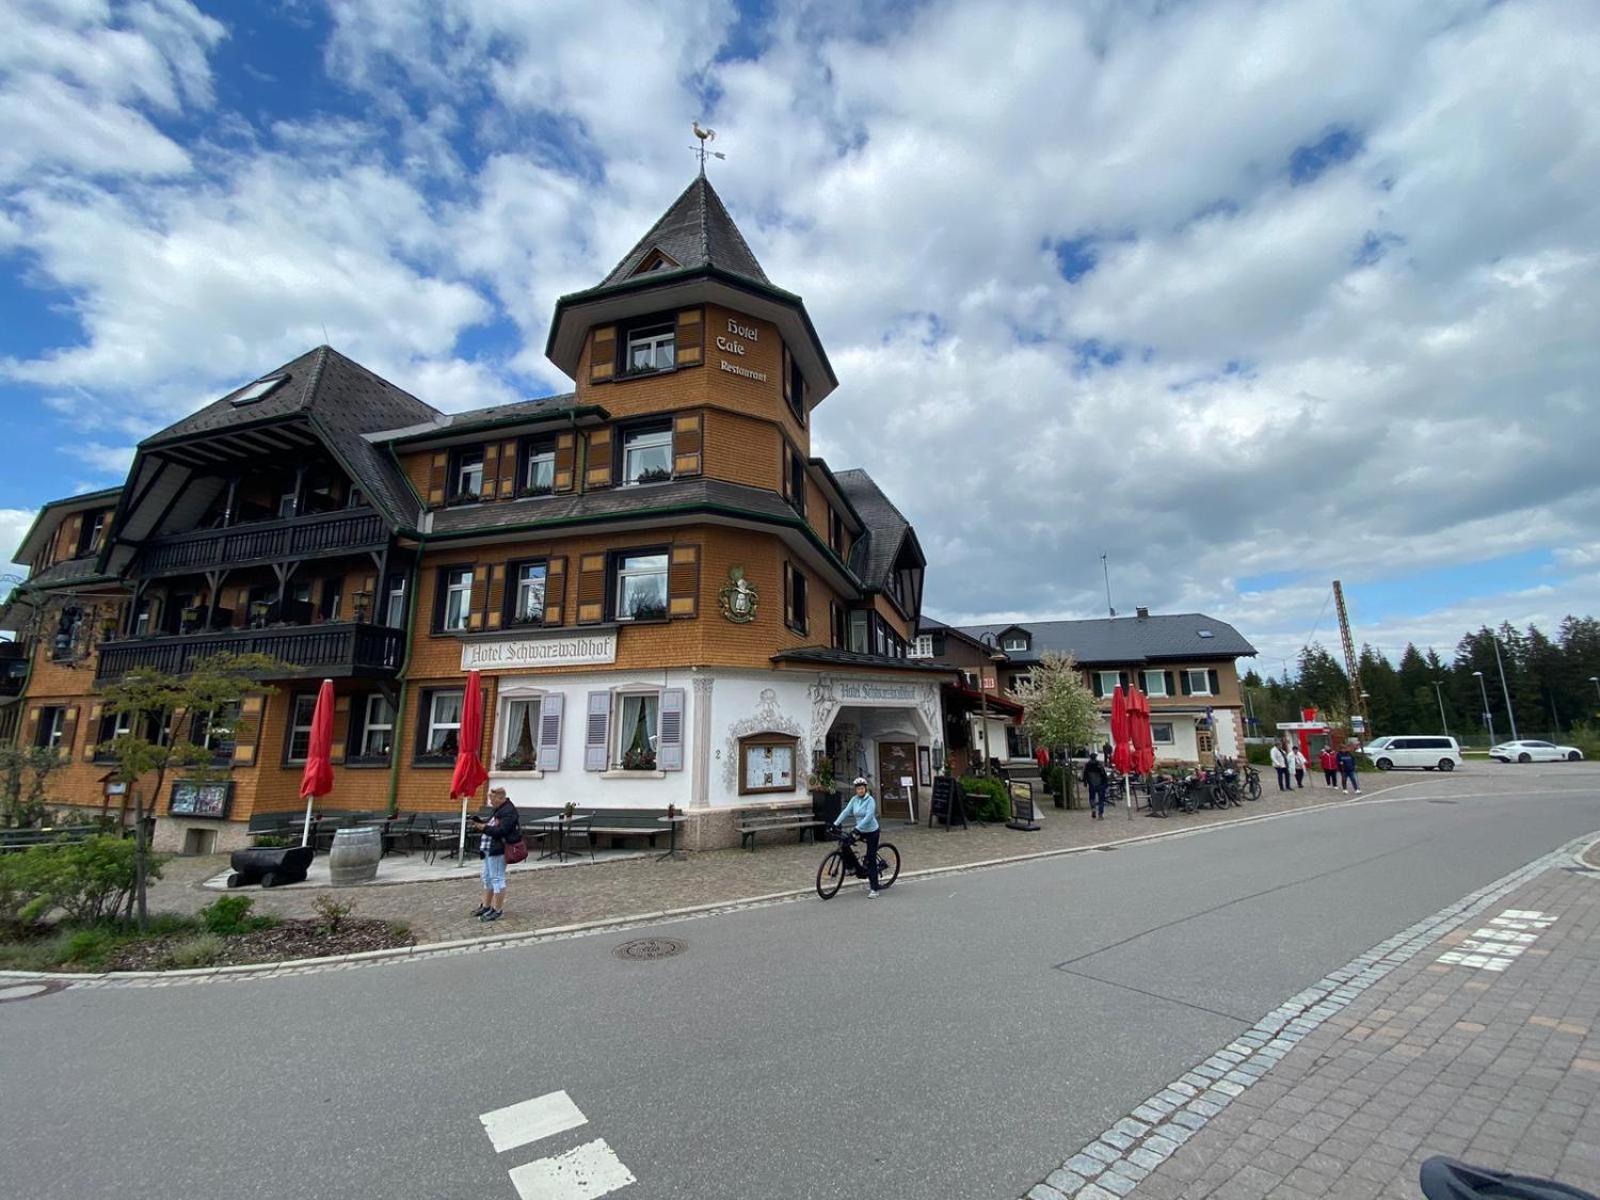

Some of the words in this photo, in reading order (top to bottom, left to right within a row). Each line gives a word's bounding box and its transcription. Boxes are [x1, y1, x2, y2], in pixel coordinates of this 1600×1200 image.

[727, 318, 758, 341] Hotel
[720, 359, 768, 382] Restaurant
[470, 643, 501, 663] Hotel
[505, 636, 610, 663] Schwarzwaldhof
[715, 748, 721, 760] 2
